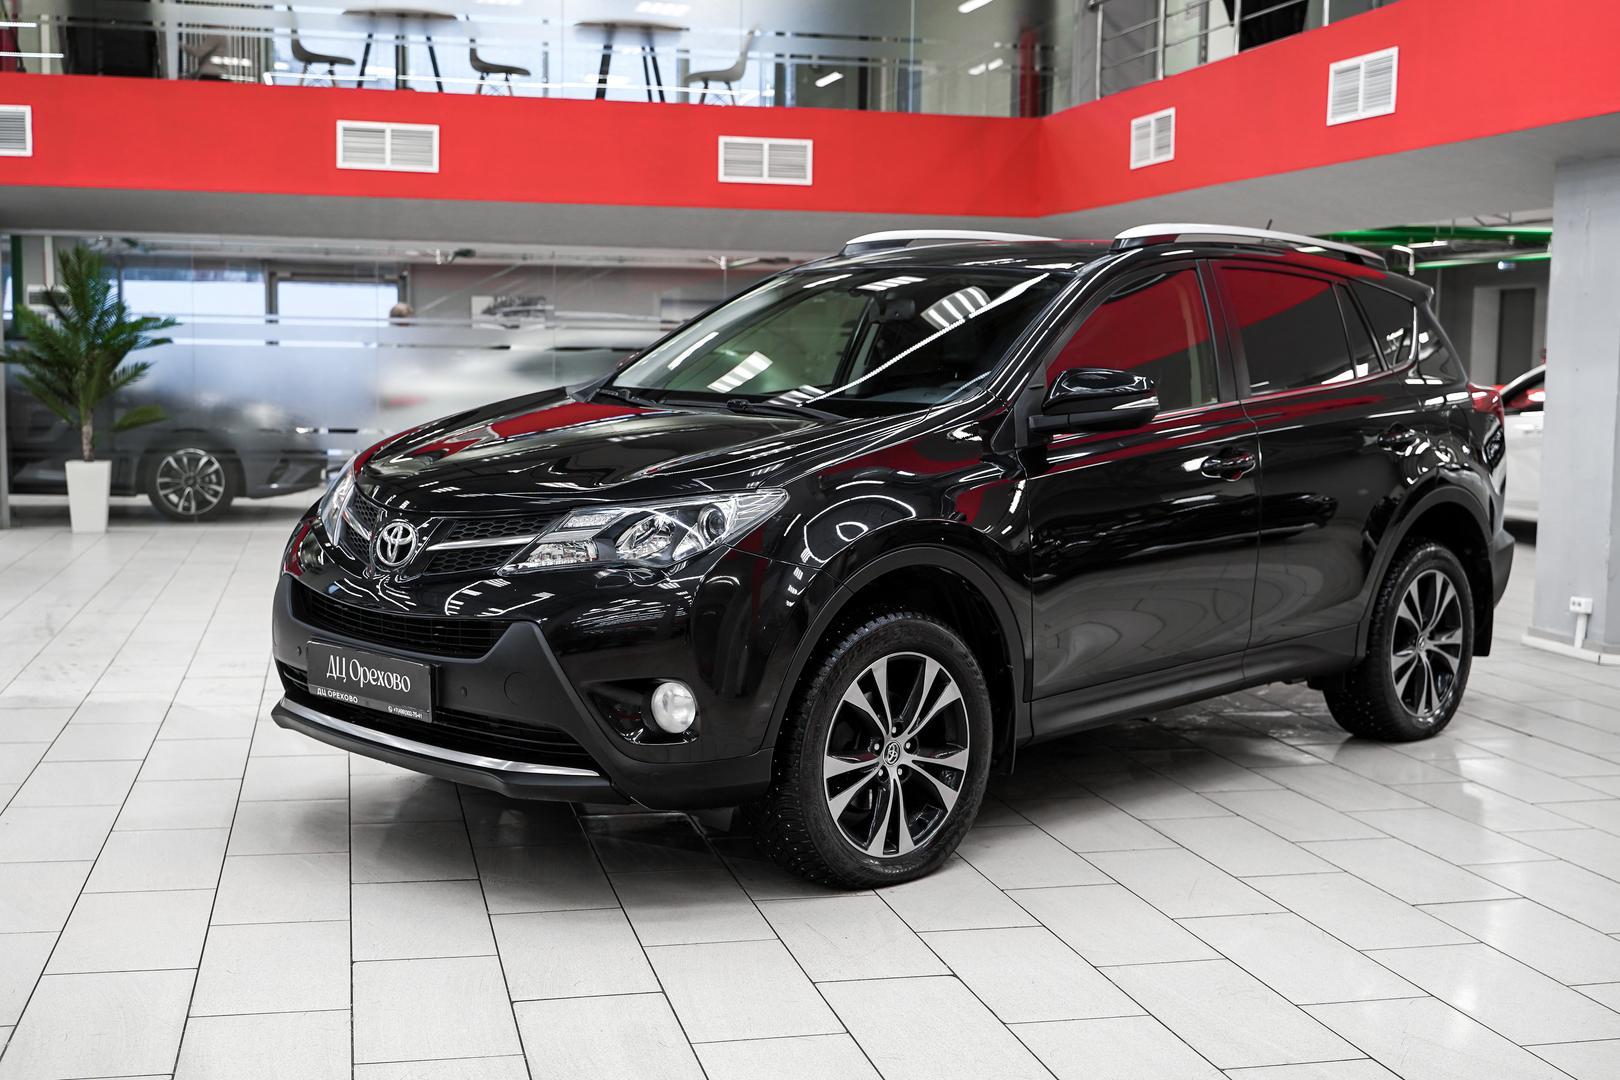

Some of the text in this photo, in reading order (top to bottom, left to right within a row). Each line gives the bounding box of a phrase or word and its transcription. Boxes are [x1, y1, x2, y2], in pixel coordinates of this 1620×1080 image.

[326, 654, 411, 693] ДЦ Орехово
[317, 687, 358, 703] ДЦ ОРЕХОВО
